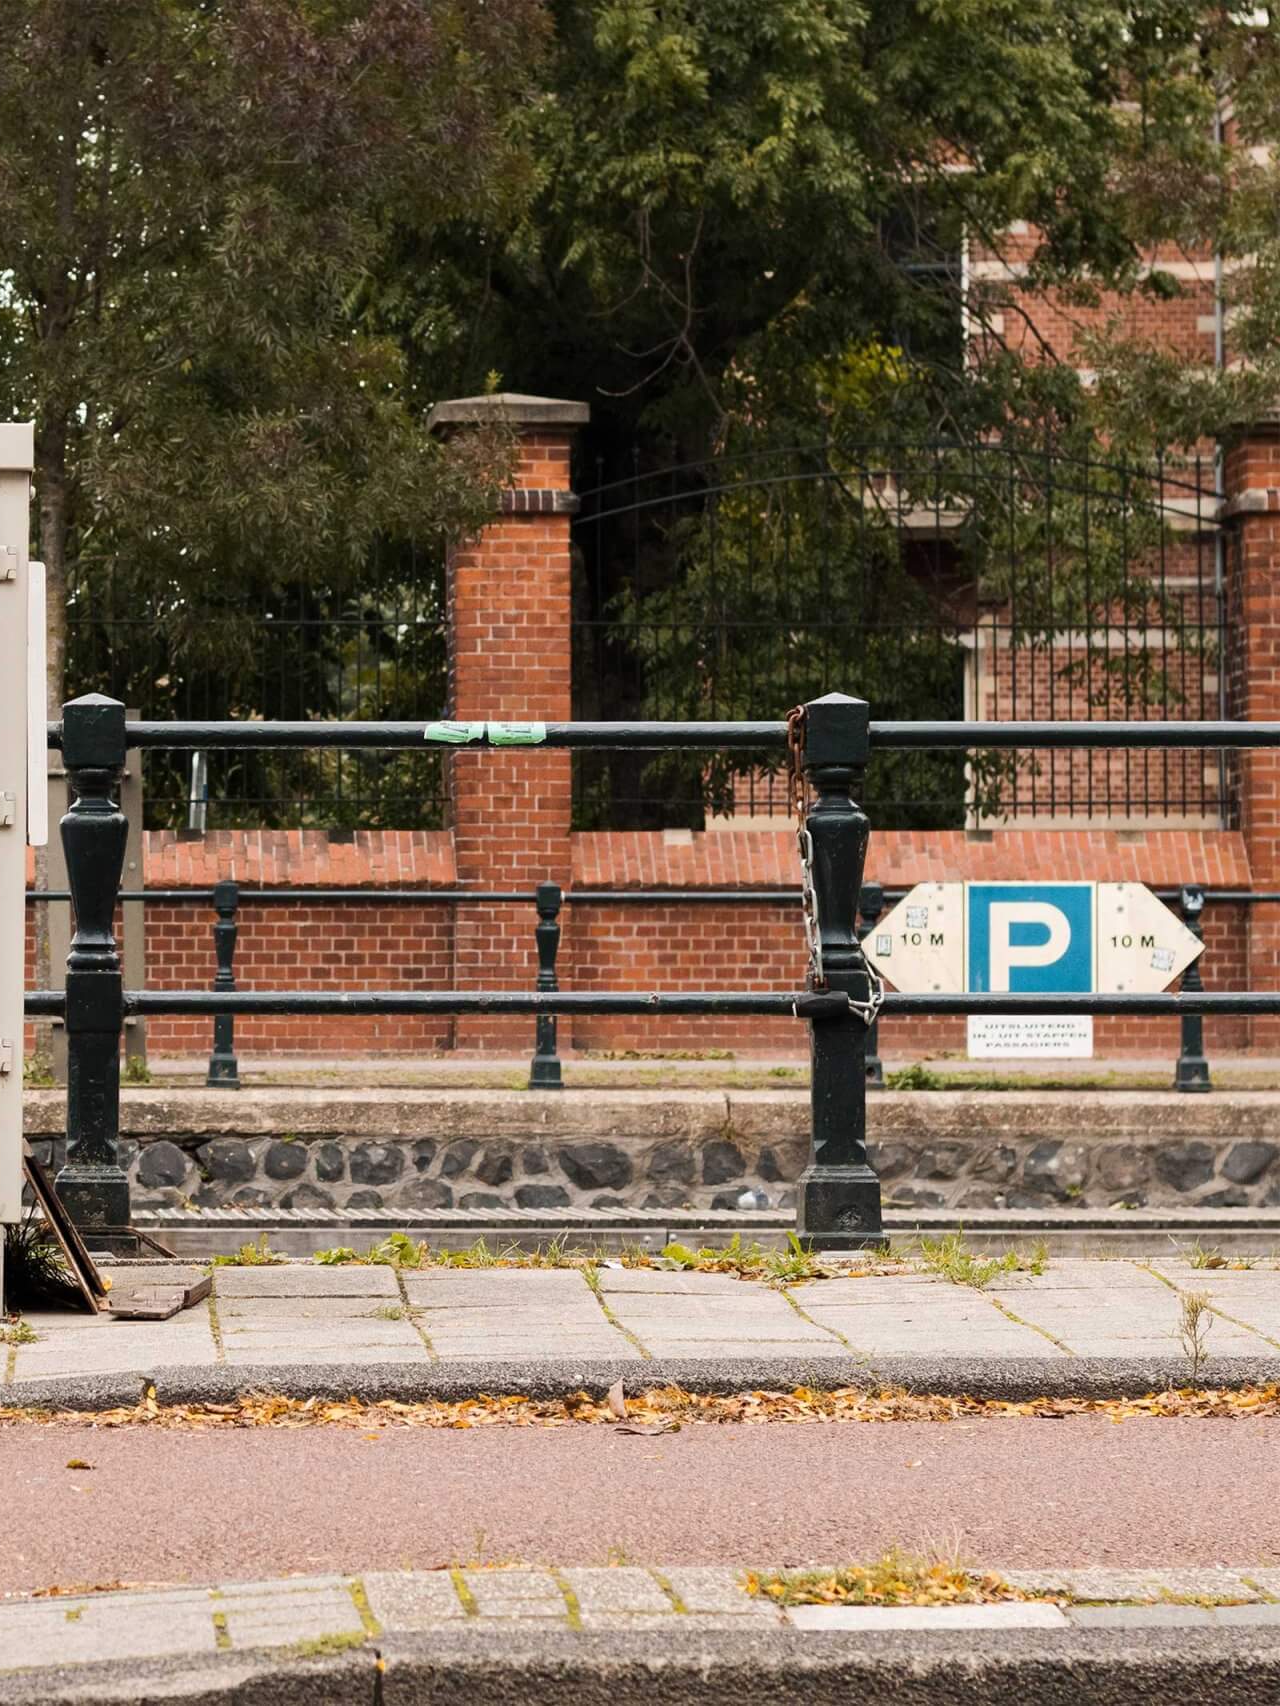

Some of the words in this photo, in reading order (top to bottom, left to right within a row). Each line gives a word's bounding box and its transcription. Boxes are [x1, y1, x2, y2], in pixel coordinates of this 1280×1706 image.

[901, 933, 922, 946] 10
[930, 933, 944, 946] M
[1111, 935, 1133, 948] 10
[1141, 935, 1155, 948] M
[989, 901, 1071, 992] P
